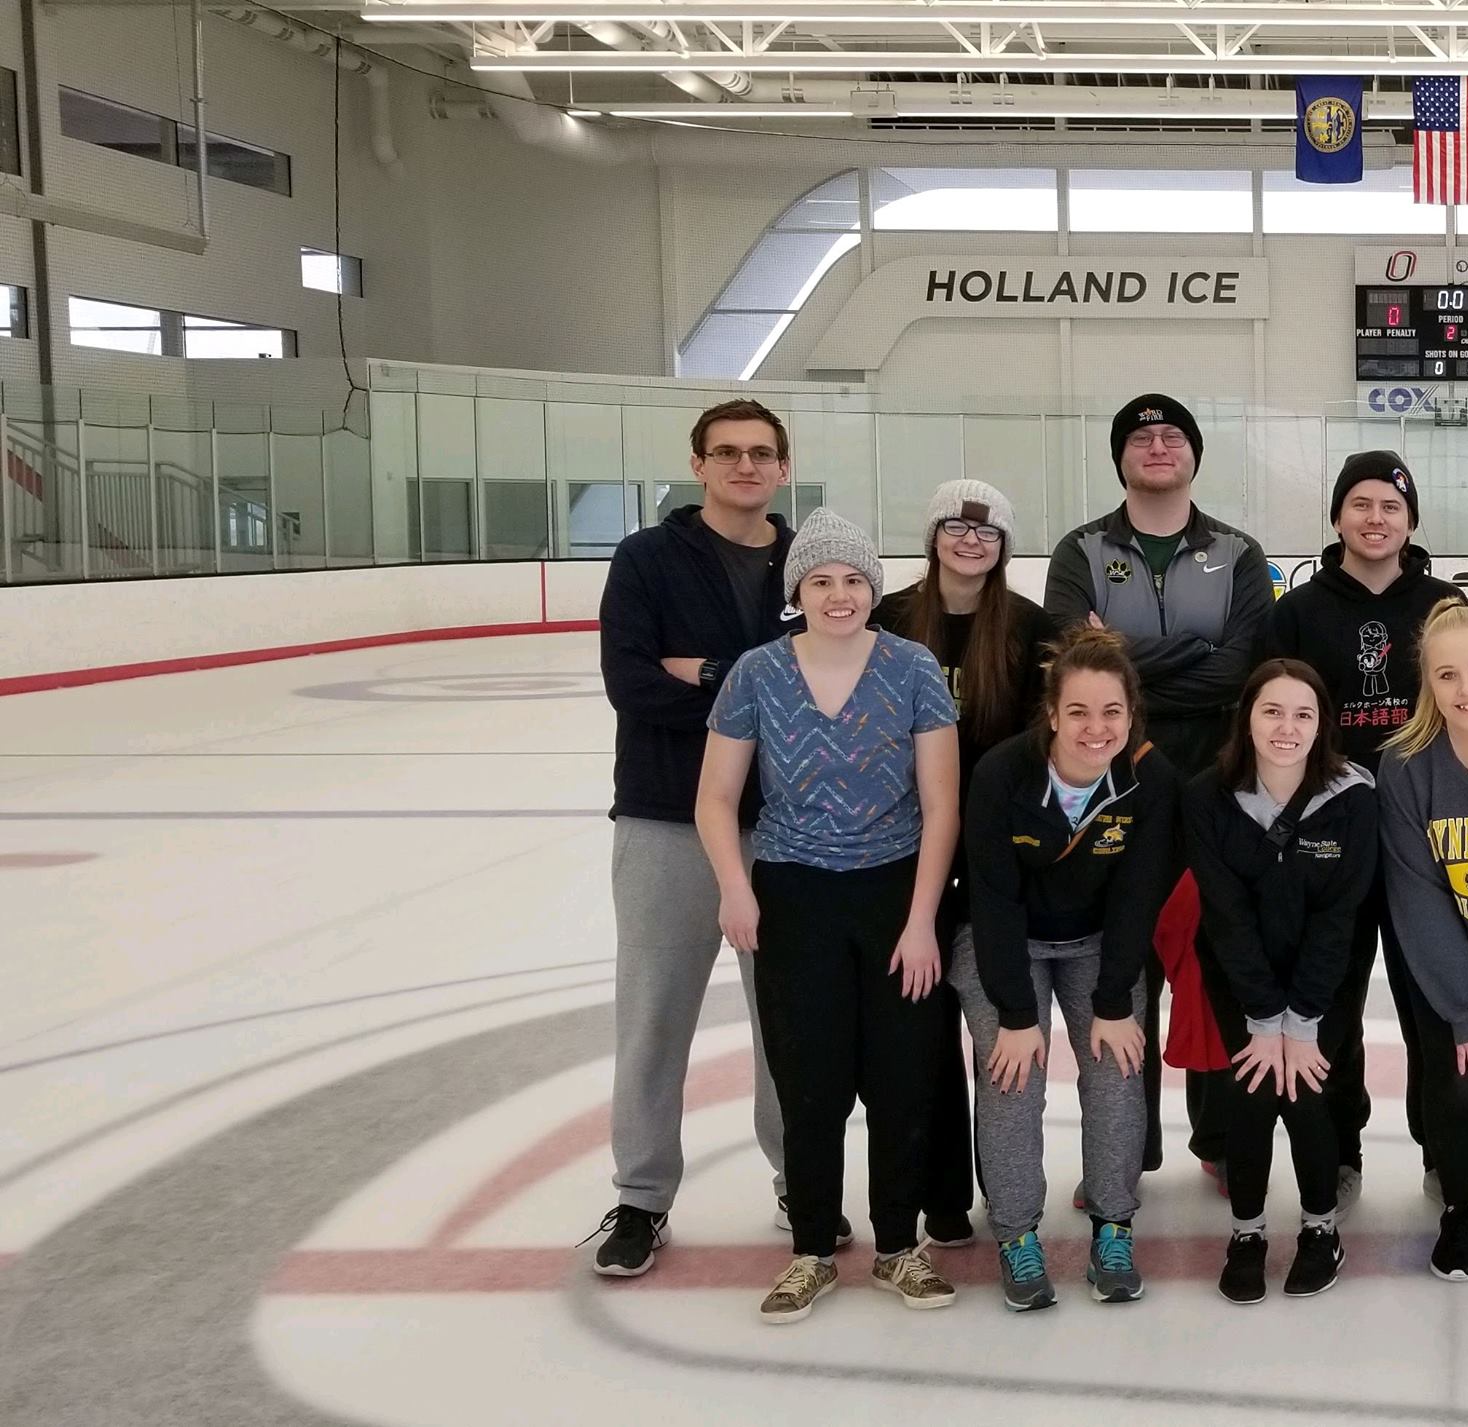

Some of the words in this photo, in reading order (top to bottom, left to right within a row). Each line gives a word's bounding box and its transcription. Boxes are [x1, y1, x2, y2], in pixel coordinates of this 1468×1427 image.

[925, 269, 1148, 303] HOLLAND
[1166, 271, 1240, 304] ICE
[1438, 315, 1464, 323] PERIOD
[1356, 329, 1382, 337] PLAYER
[1386, 329, 1416, 337] PENALTY
[1446, 326, 1455, 340] 2
[1425, 350, 1447, 358] SHOTS
[1448, 350, 1458, 358] ON
[1434, 361, 1444, 375] 0
[1368, 386, 1438, 413] COX
[1340, 707, 1409, 727] 日本語部
